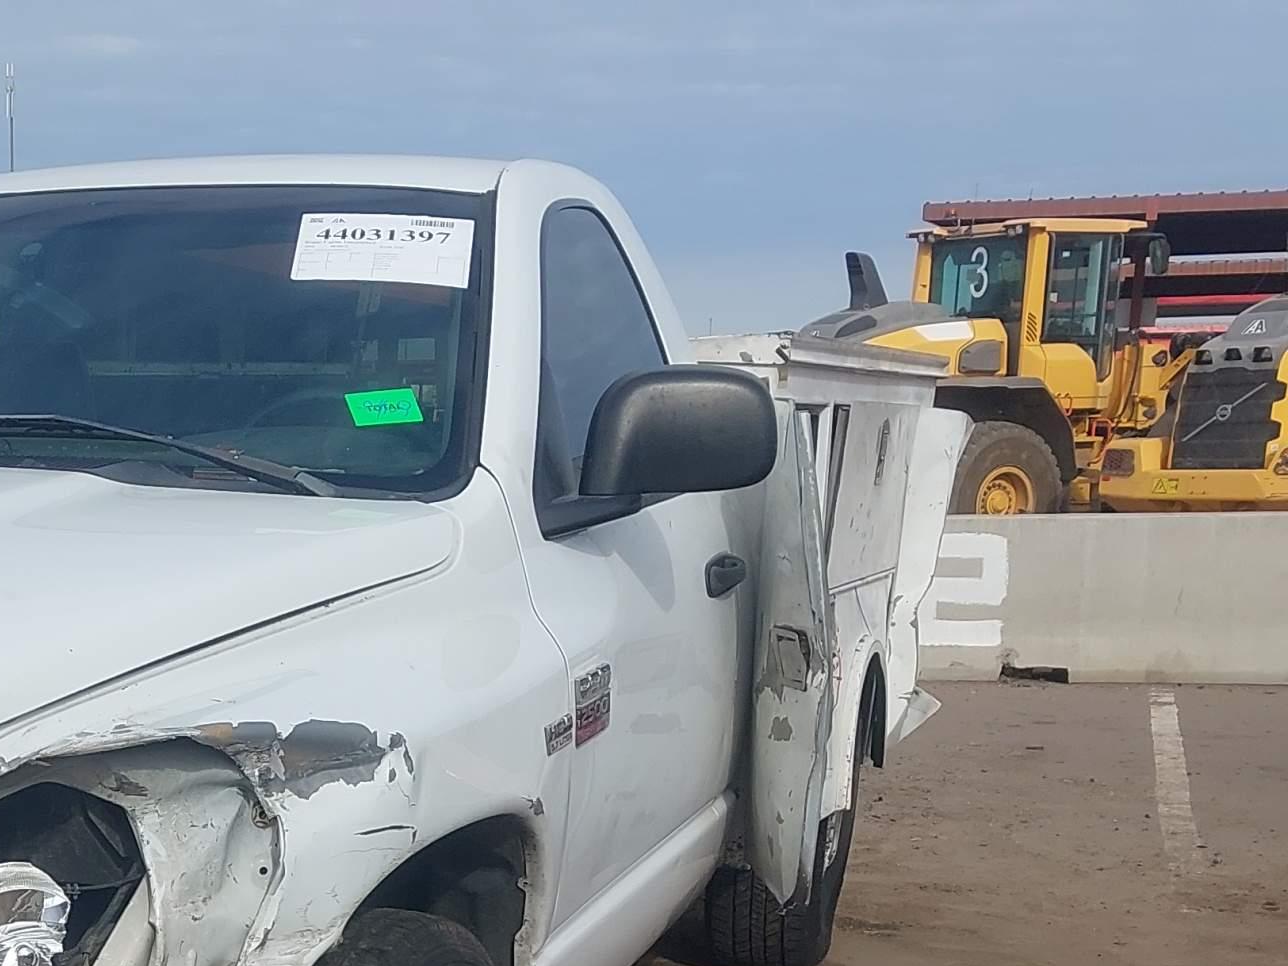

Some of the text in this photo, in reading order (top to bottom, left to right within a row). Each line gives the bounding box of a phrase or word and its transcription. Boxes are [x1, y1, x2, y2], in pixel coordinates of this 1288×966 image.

[316, 228, 452, 245] 44031397
[969, 246, 989, 298] 3
[918, 532, 1010, 647] 2
